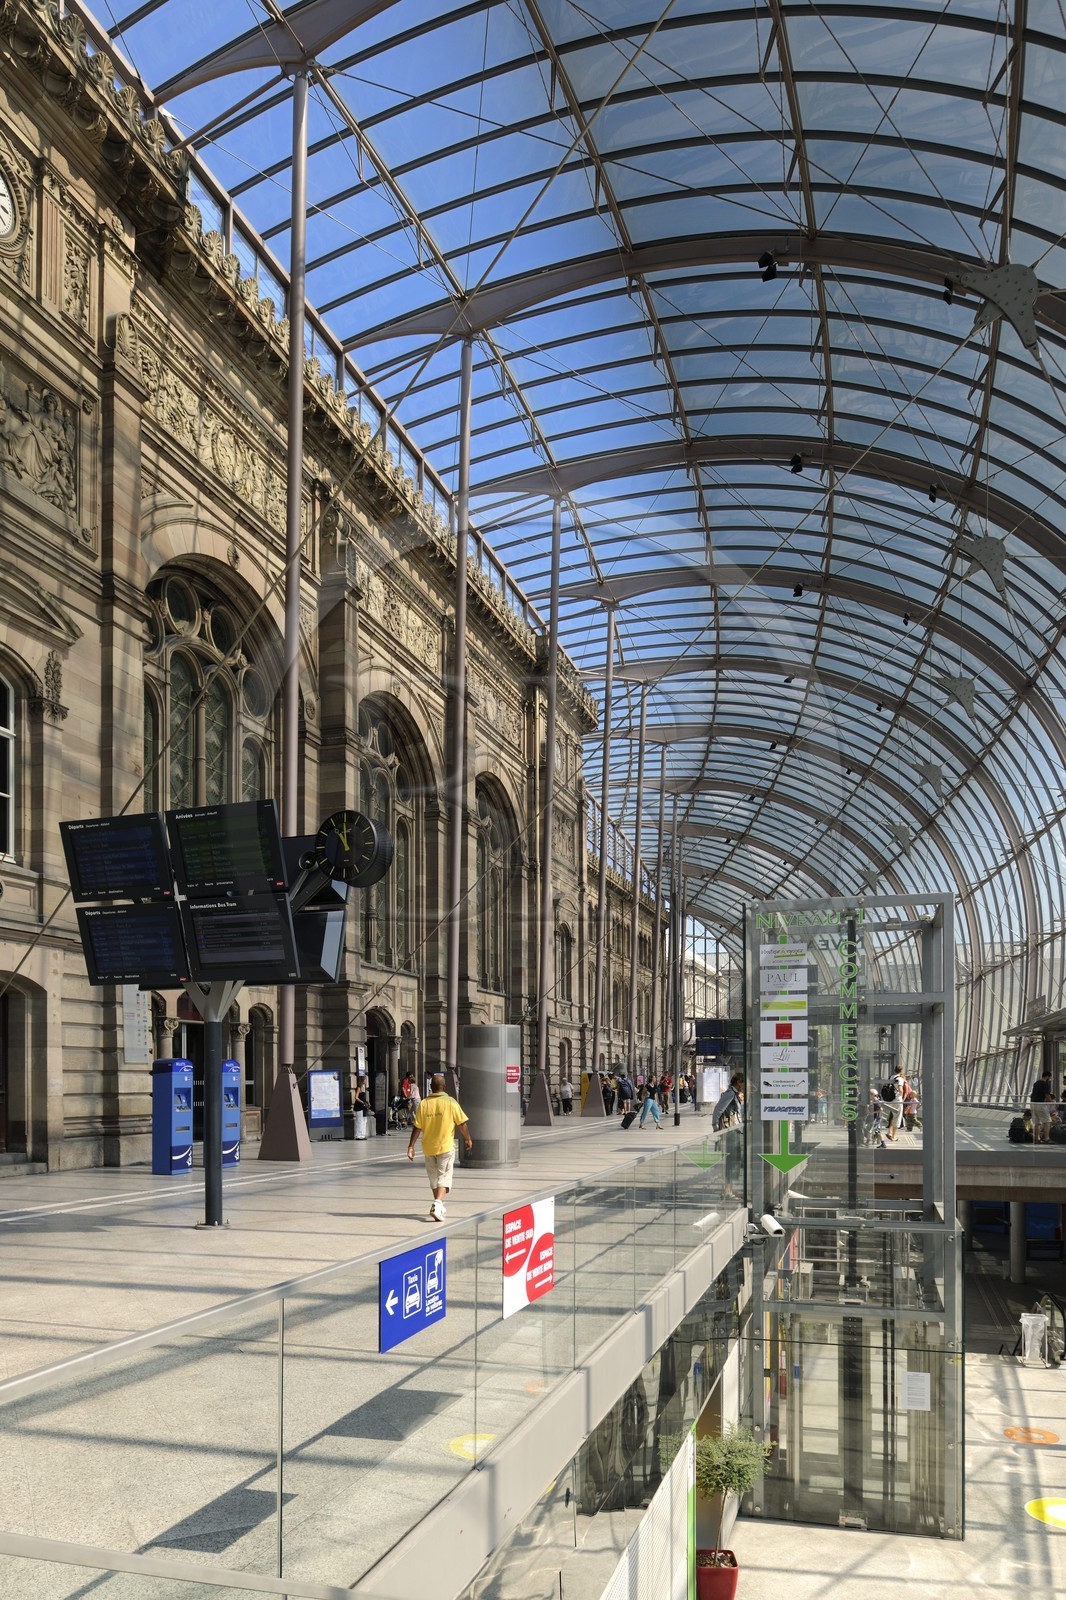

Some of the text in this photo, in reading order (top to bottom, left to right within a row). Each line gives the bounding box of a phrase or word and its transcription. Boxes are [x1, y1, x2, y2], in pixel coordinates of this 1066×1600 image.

[755, 912, 841, 929] NIVEAU
[767, 973, 801, 983] PAUL
[839, 941, 858, 1122] COMMERCES
[505, 1219, 522, 1234] ESPACE
[505, 1237, 512, 1249] DE
[526, 1228, 534, 1240] SUD
[539, 1247, 553, 1261] ESPACE
[526, 1271, 532, 1282] DE
